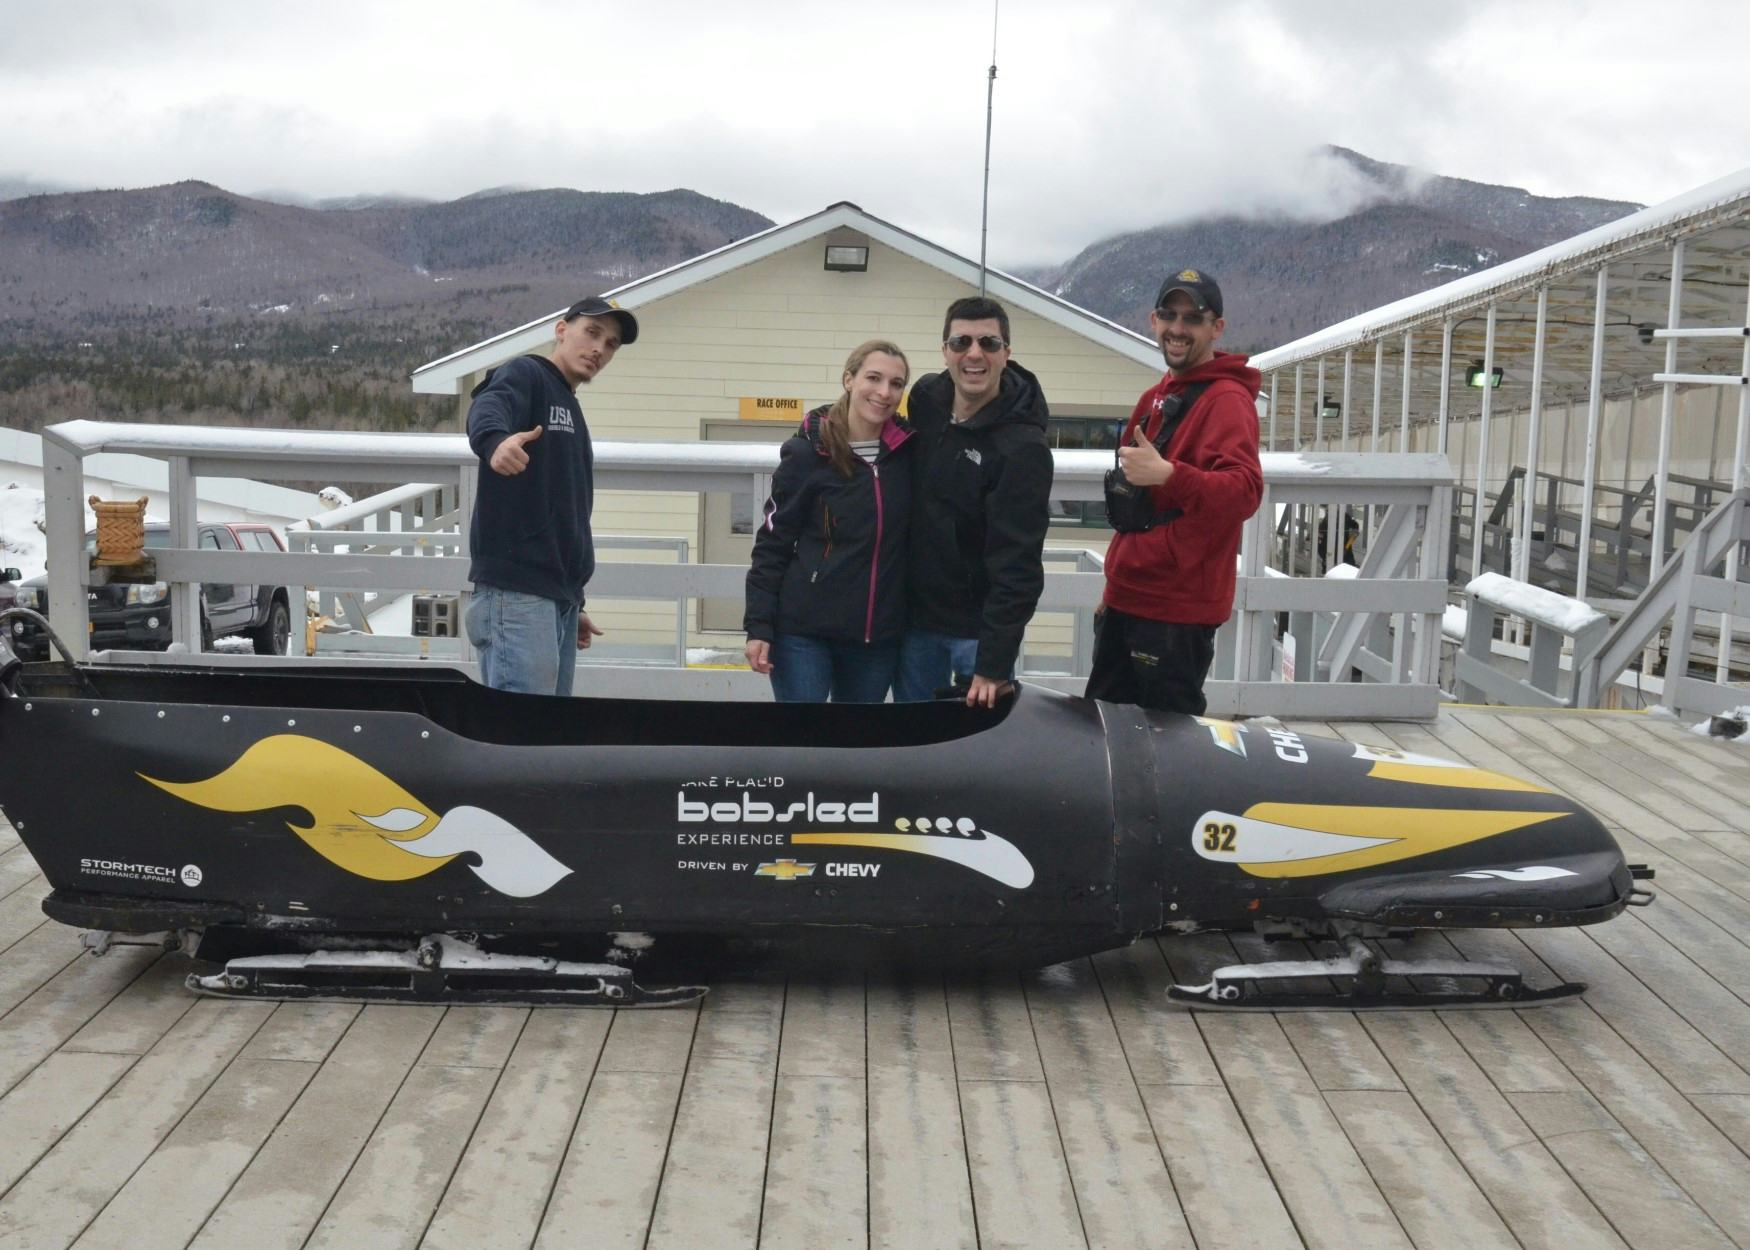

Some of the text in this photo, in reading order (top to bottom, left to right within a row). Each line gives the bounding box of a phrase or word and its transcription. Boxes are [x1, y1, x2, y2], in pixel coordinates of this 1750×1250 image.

[757, 398, 798, 409] RACE OFFICE
[549, 405, 574, 427] USA
[678, 791, 879, 823] bobsled
[677, 833, 785, 846] EXPERIENCE
[1203, 822, 1237, 853] 32
[80, 858, 176, 877] STORMTECH
[81, 867, 176, 884] PERFORMANCE APPAREL
[678, 860, 881, 877] DRIVEN BY CHEVY
